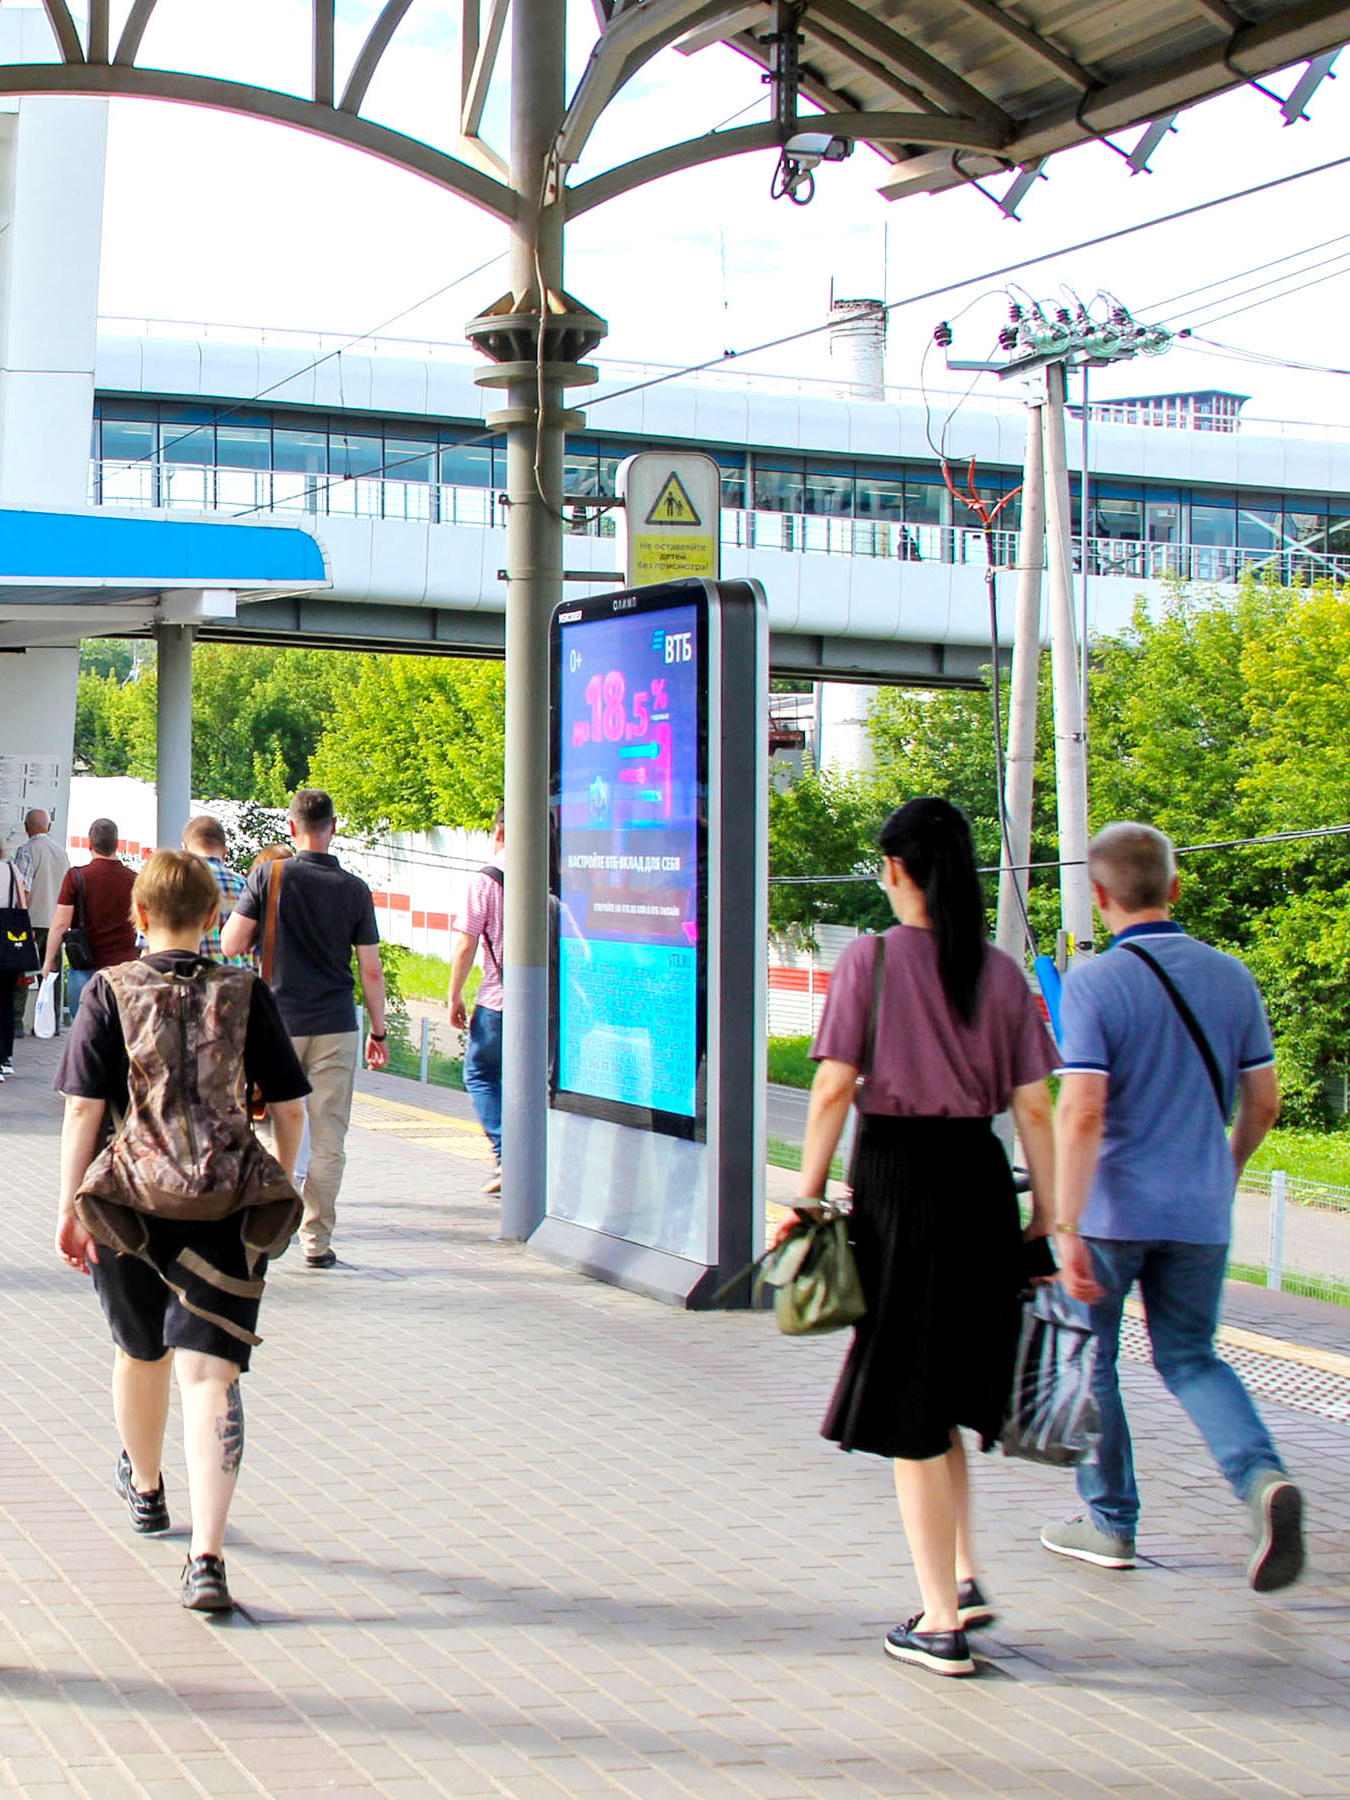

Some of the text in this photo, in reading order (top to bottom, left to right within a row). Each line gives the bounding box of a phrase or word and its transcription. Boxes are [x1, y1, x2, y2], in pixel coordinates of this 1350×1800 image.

[639, 542, 651, 551] Не
[658, 552, 687, 561] детей
[664, 632, 692, 664] ВТБ
